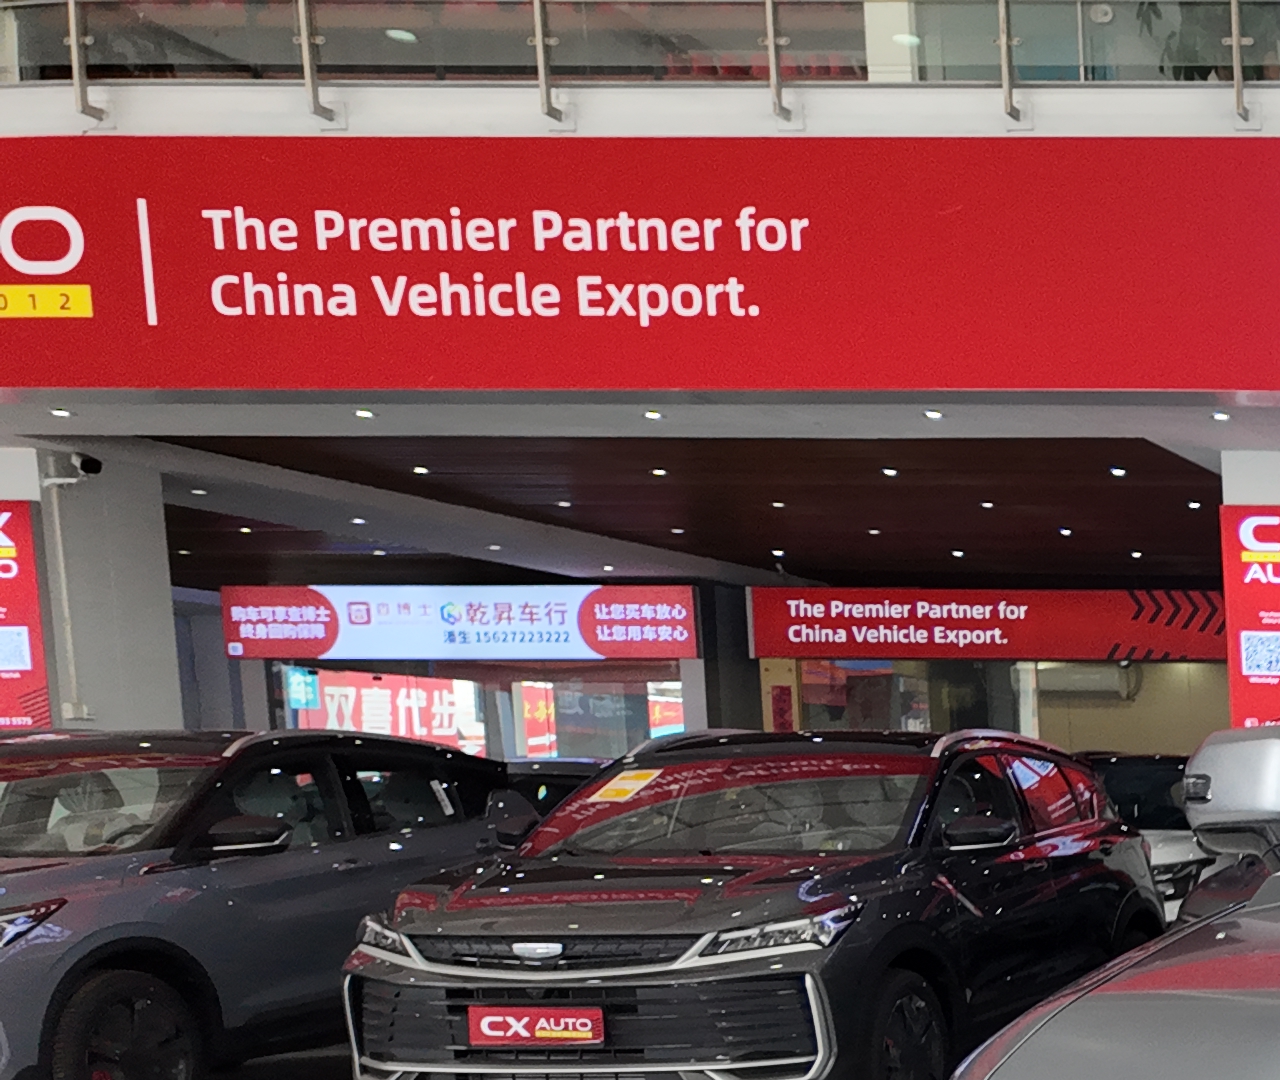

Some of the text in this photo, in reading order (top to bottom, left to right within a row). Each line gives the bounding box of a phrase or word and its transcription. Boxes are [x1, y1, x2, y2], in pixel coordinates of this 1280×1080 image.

[202, 206, 809, 251] The Premier Partner for
[211, 272, 760, 327] China Vehicle Export.
[787, 599, 1028, 619] The Premier Partner for
[788, 624, 1009, 648] China Vehicle Export.
[480, 1015, 531, 1038] CX
[535, 1017, 592, 1031] AUTO
